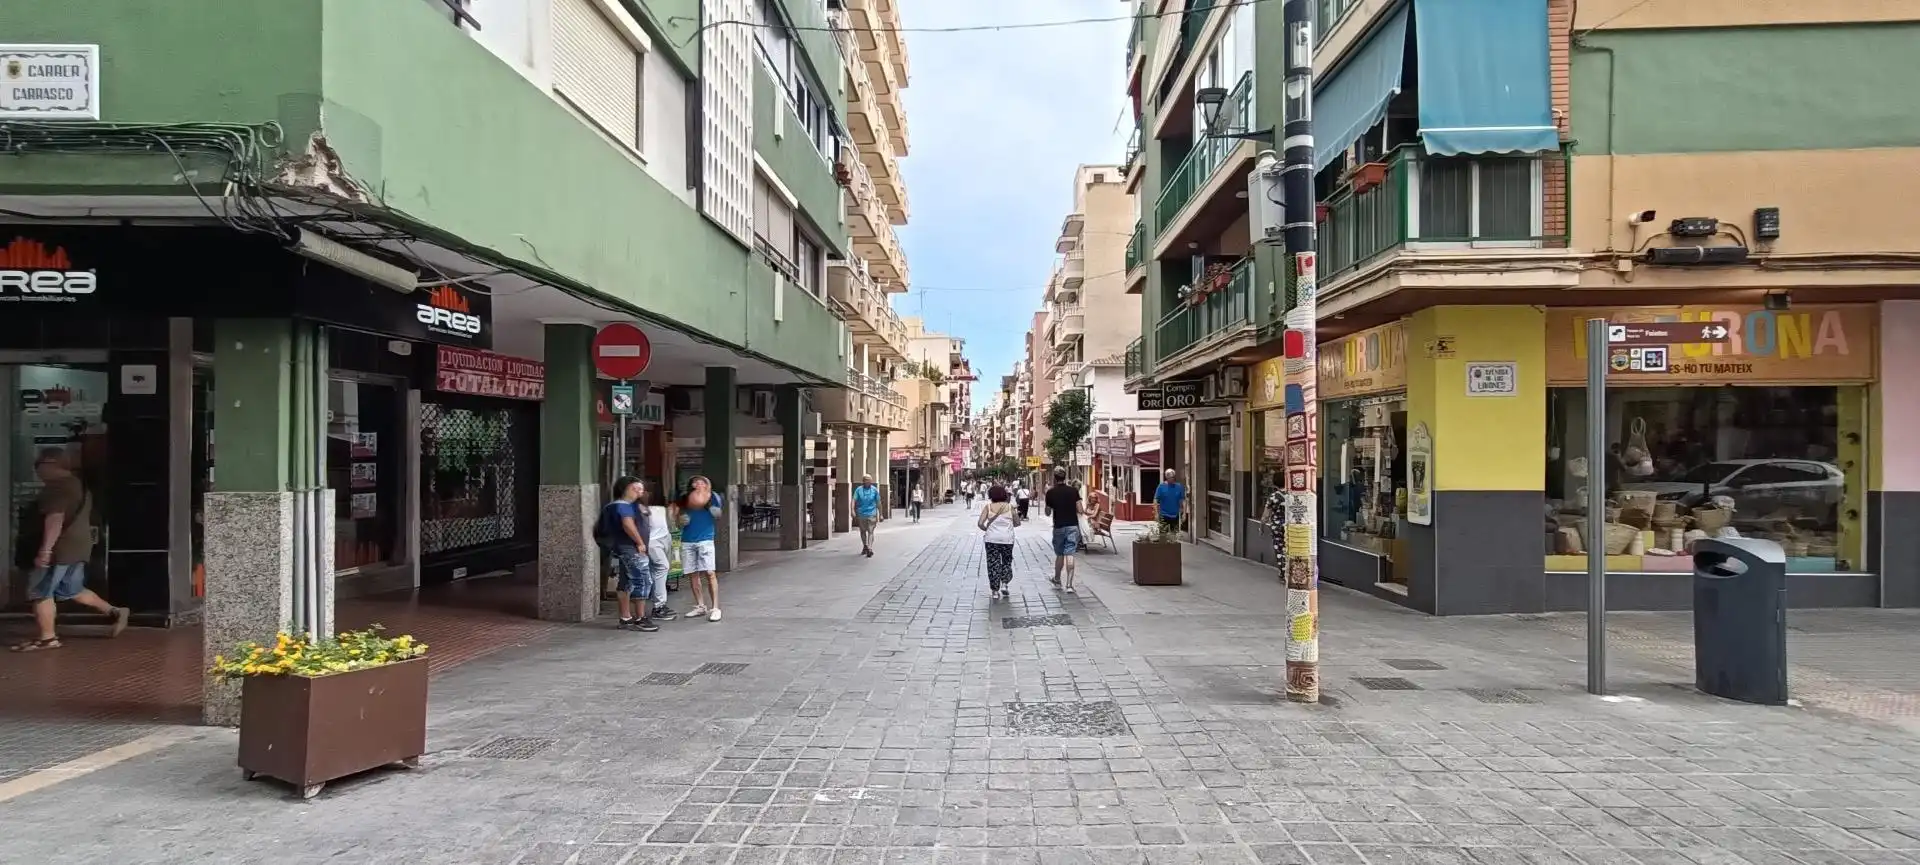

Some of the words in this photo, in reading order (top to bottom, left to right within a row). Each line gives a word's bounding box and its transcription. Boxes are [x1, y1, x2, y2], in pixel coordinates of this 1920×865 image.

[28, 64, 80, 77] CARRER
[13, 87, 73, 100] CARRASCO
[1701, 363, 1712, 373] TU
[1714, 363, 1753, 373] MATEIX
[440, 371, 504, 396] TOTAL
[1166, 395, 1195, 408] ORO
